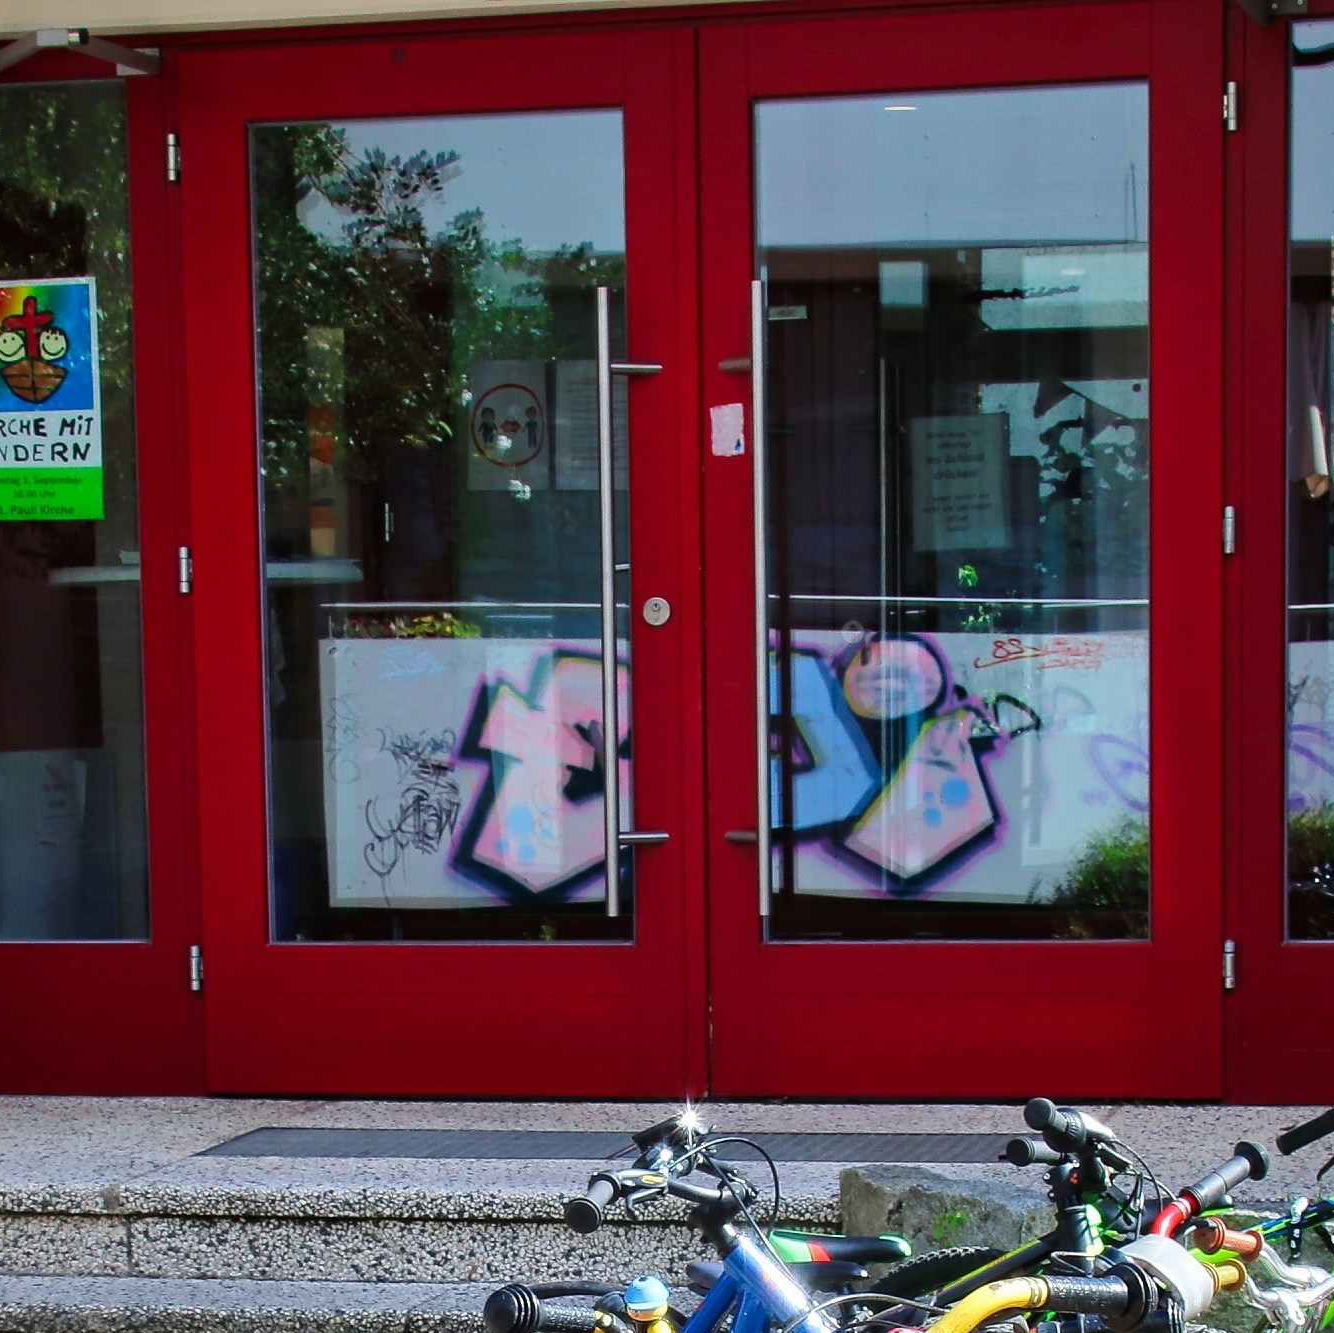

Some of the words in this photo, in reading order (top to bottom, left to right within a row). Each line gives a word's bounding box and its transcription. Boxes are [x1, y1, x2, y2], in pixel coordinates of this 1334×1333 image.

[33, 475, 82, 486] September
[10, 504, 37, 515] Pauli
[40, 504, 75, 515] Kirche
